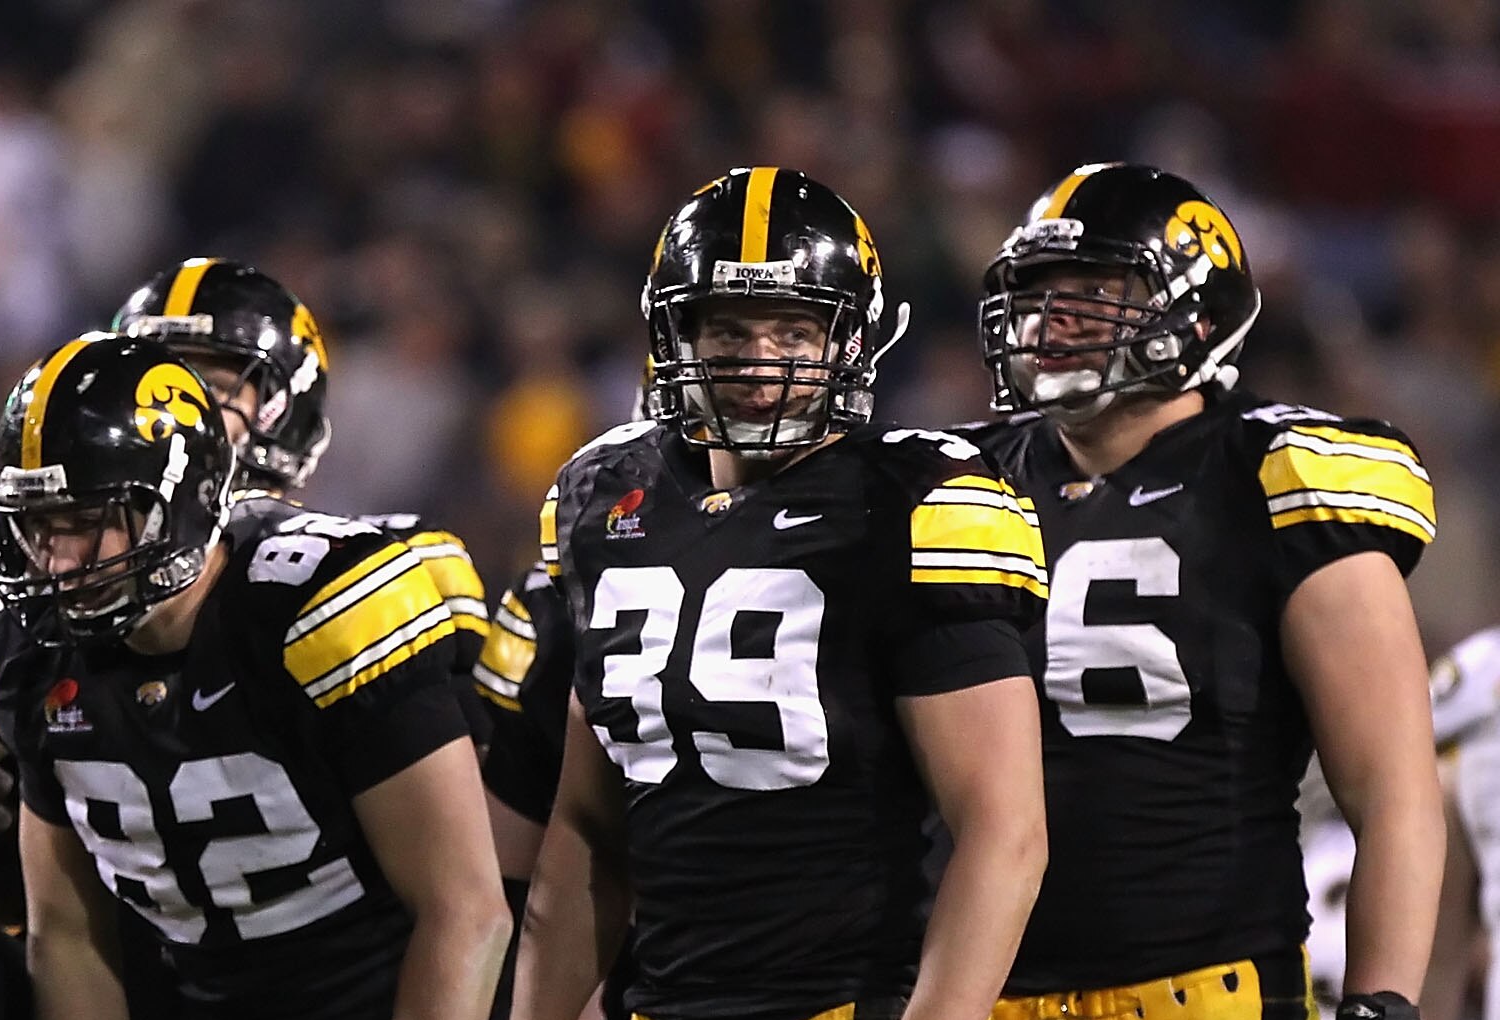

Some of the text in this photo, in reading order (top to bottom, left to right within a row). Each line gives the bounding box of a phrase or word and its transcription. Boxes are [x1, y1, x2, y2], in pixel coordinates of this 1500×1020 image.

[735, 267, 774, 280] IOWA
[589, 564, 831, 793] 39
[53, 751, 366, 946] 82
